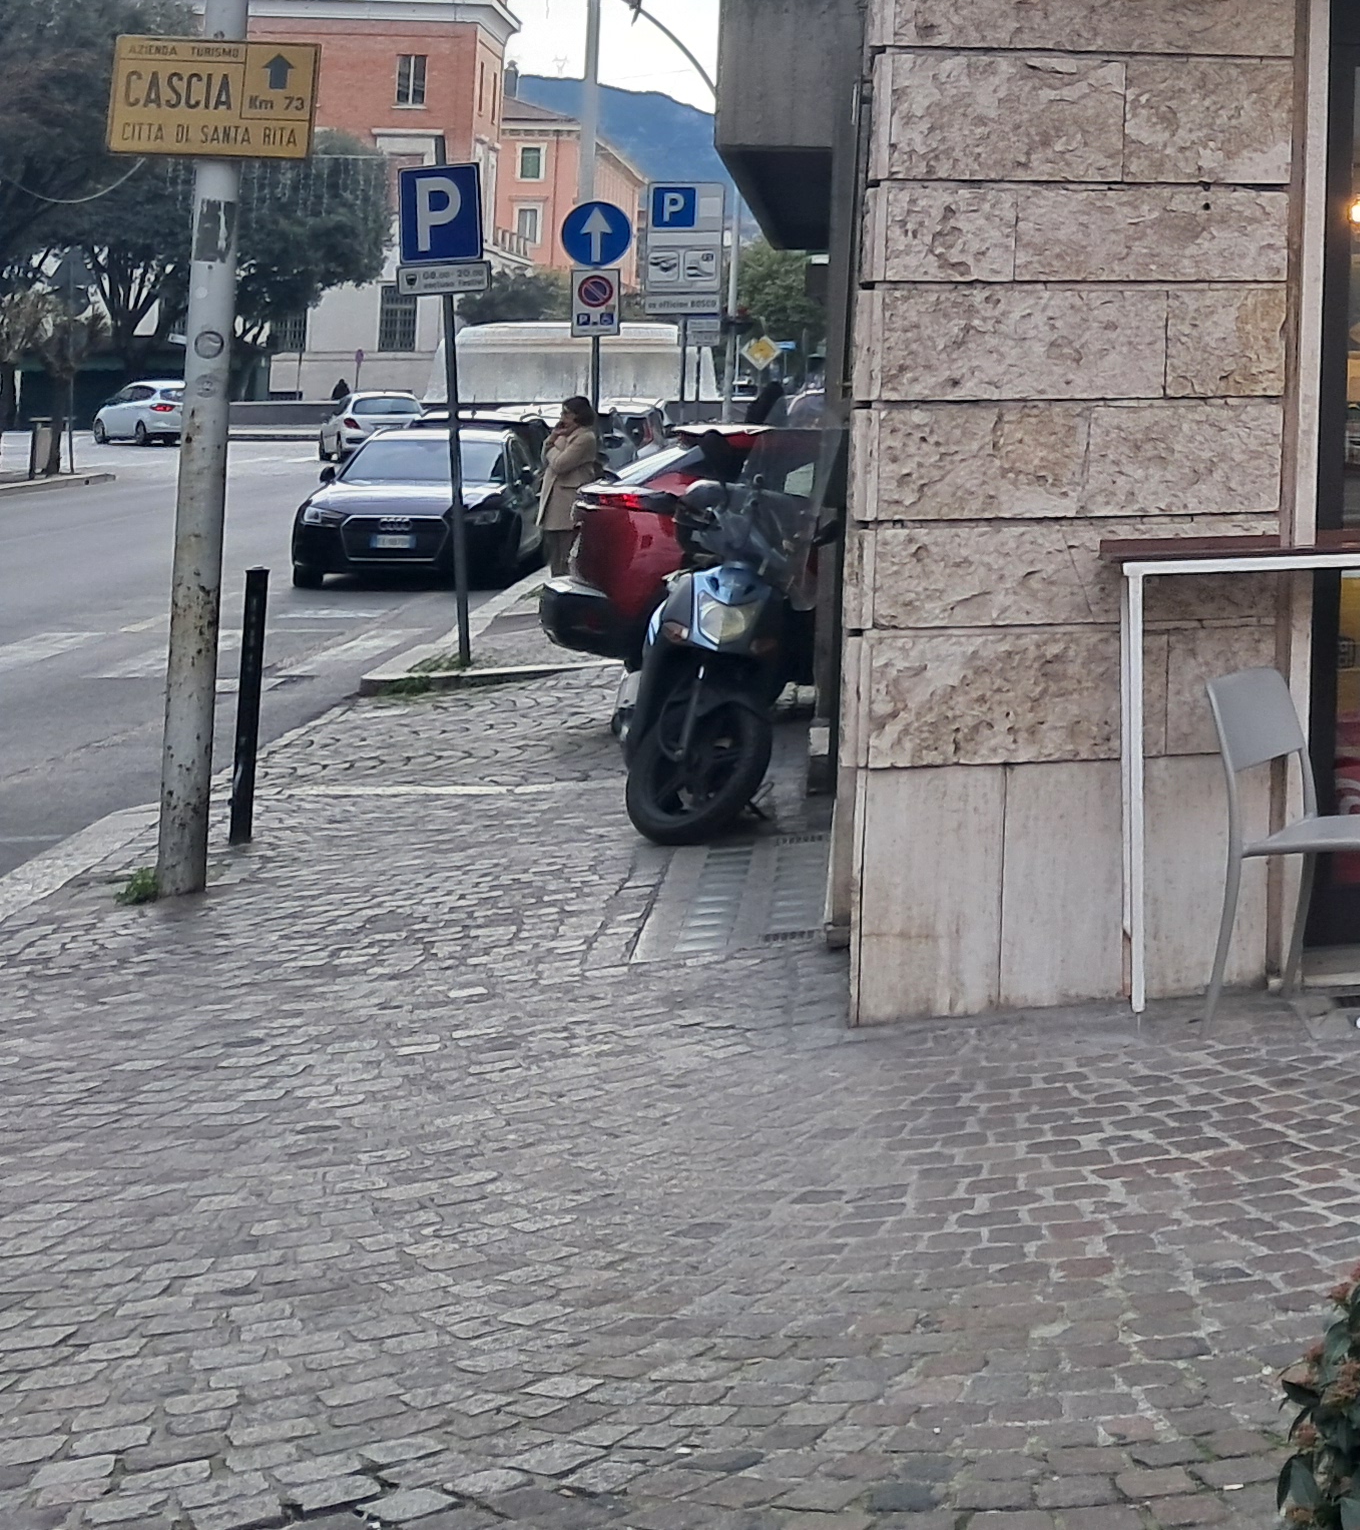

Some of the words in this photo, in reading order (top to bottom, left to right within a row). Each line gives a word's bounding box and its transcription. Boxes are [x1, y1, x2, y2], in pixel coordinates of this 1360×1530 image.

[128, 43, 178, 56] AZIENDA
[189, 45, 240, 58] TURISMO
[124, 70, 232, 110] CASCIA
[249, 95, 274, 110] Km
[283, 96, 305, 111] 73
[175, 124, 190, 144] DI
[200, 125, 251, 146] SANTA
[263, 126, 298, 147] RITA
[415, 176, 461, 252] P
[663, 192, 685, 223] P
